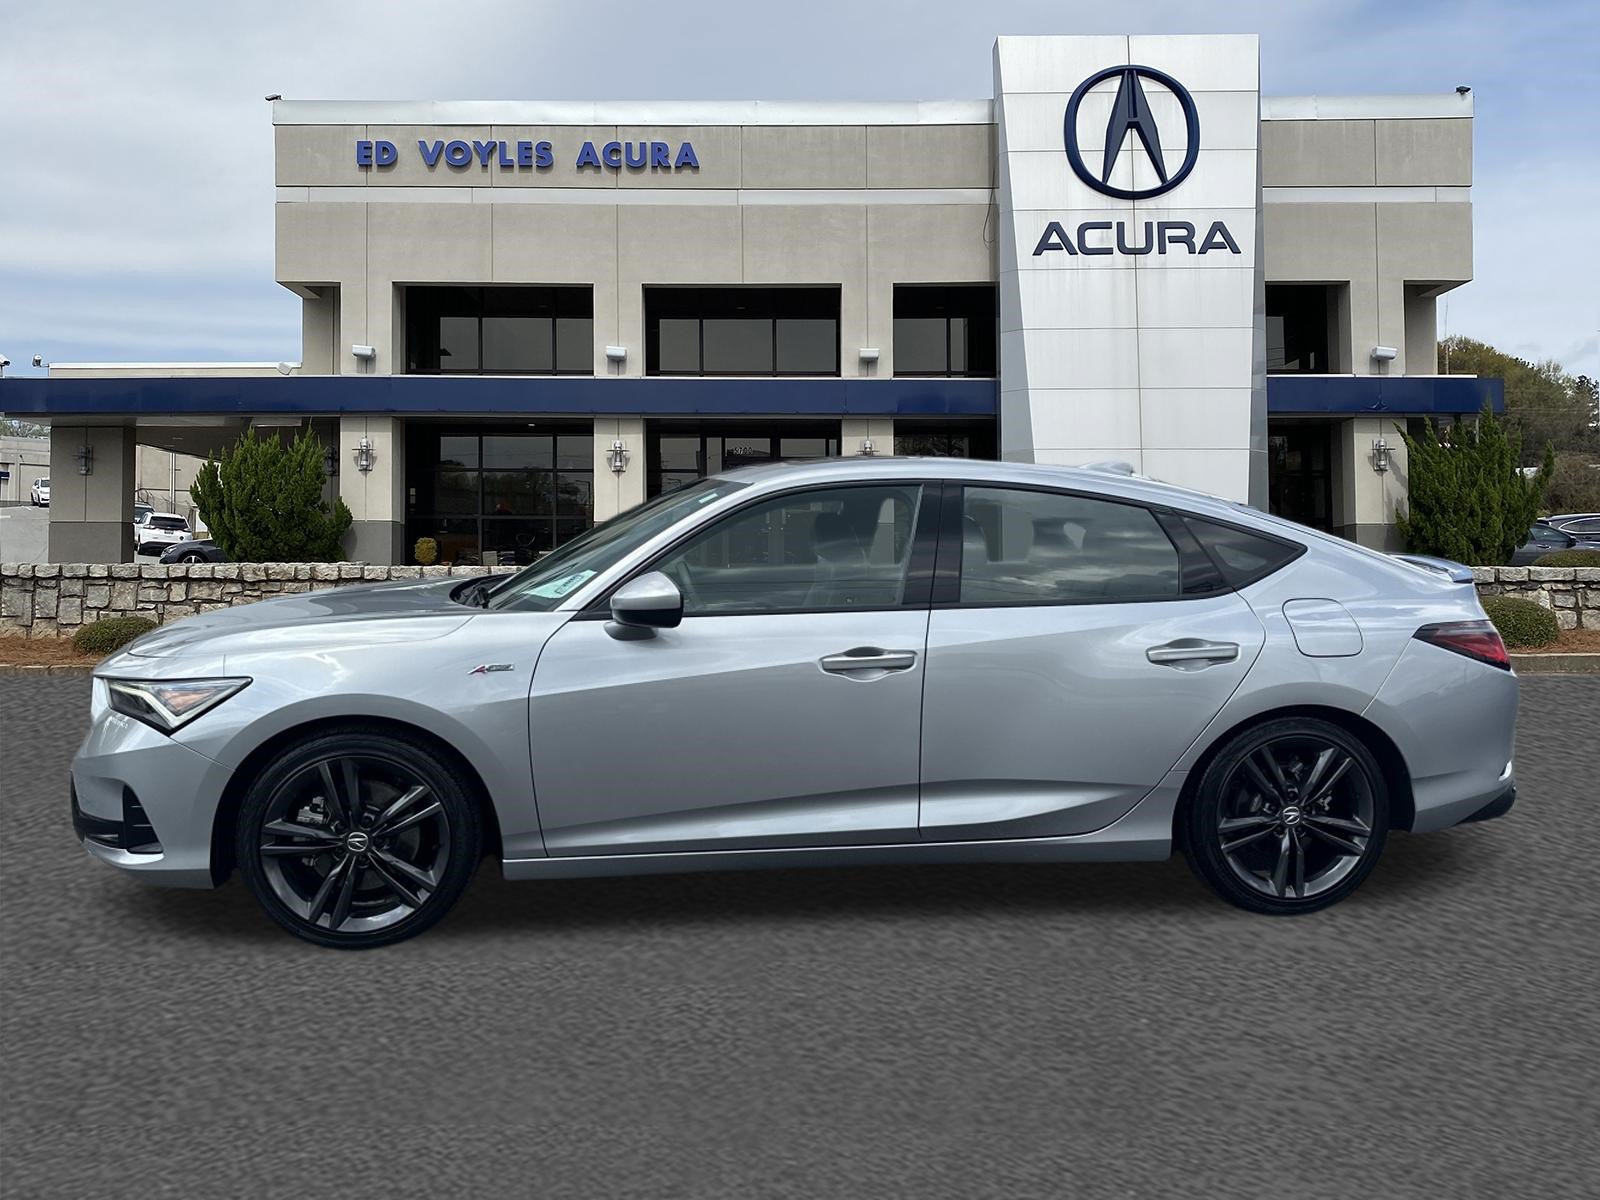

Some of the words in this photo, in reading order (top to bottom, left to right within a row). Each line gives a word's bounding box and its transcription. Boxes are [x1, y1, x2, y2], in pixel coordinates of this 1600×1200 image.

[356, 140, 398, 167] ED
[418, 140, 554, 168] VOYLES
[576, 141, 700, 168] ACURA
[1032, 221, 1242, 256] ACURA
